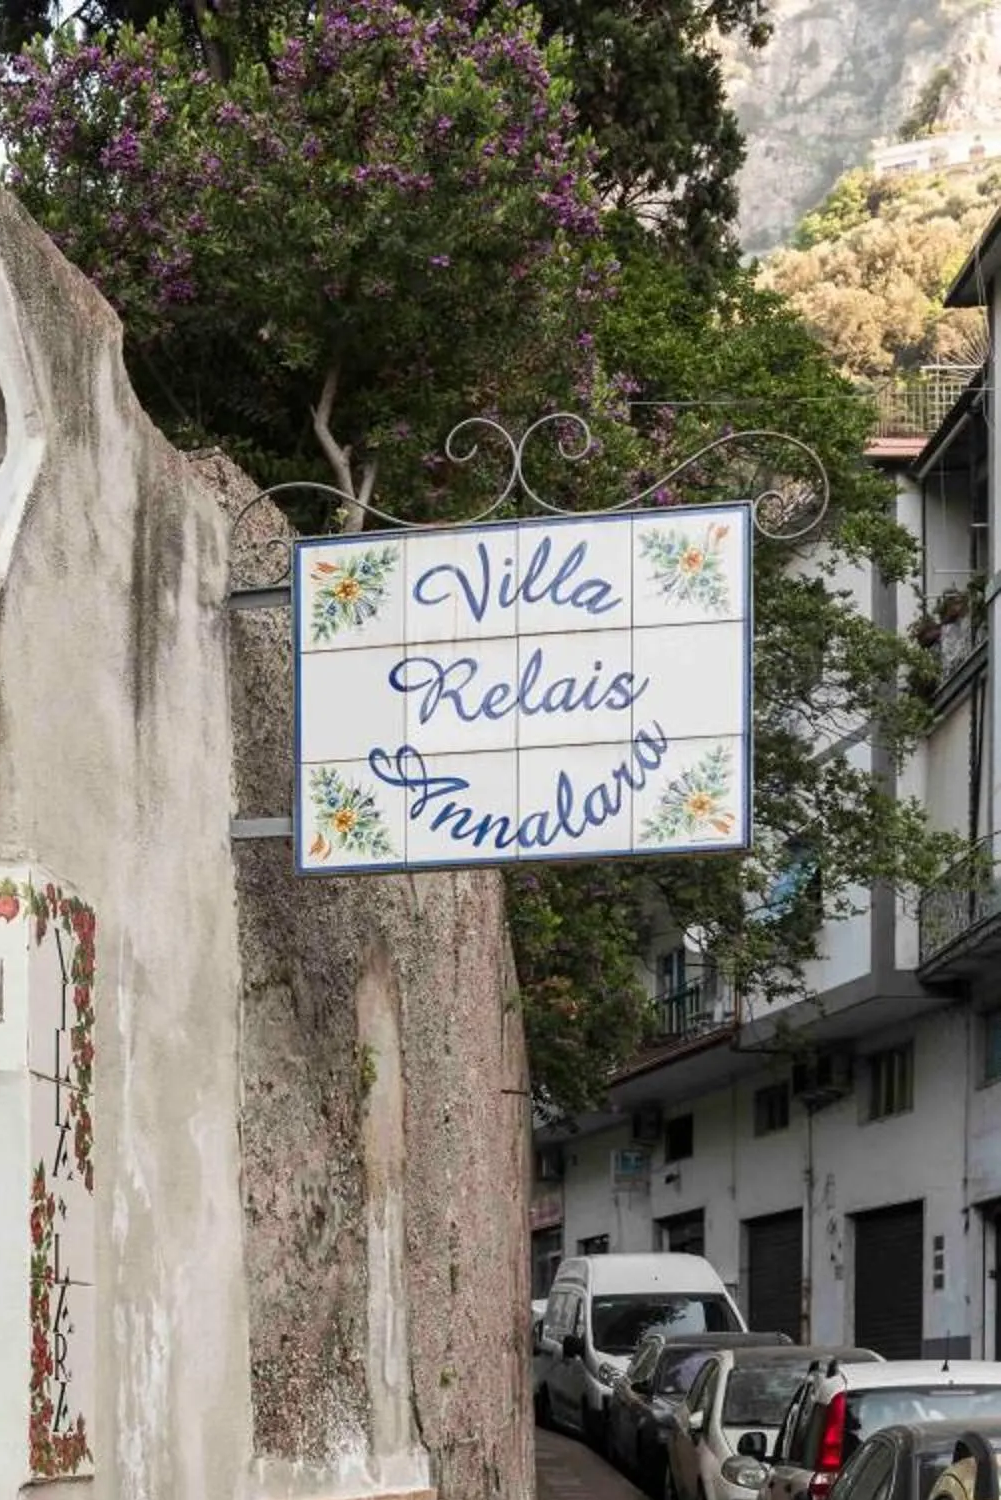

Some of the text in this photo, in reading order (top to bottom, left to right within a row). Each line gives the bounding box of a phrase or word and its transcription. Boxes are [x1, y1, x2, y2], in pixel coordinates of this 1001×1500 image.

[412, 535, 624, 624] Villa
[388, 647, 650, 725] Relais
[368, 719, 667, 849] Annalara
